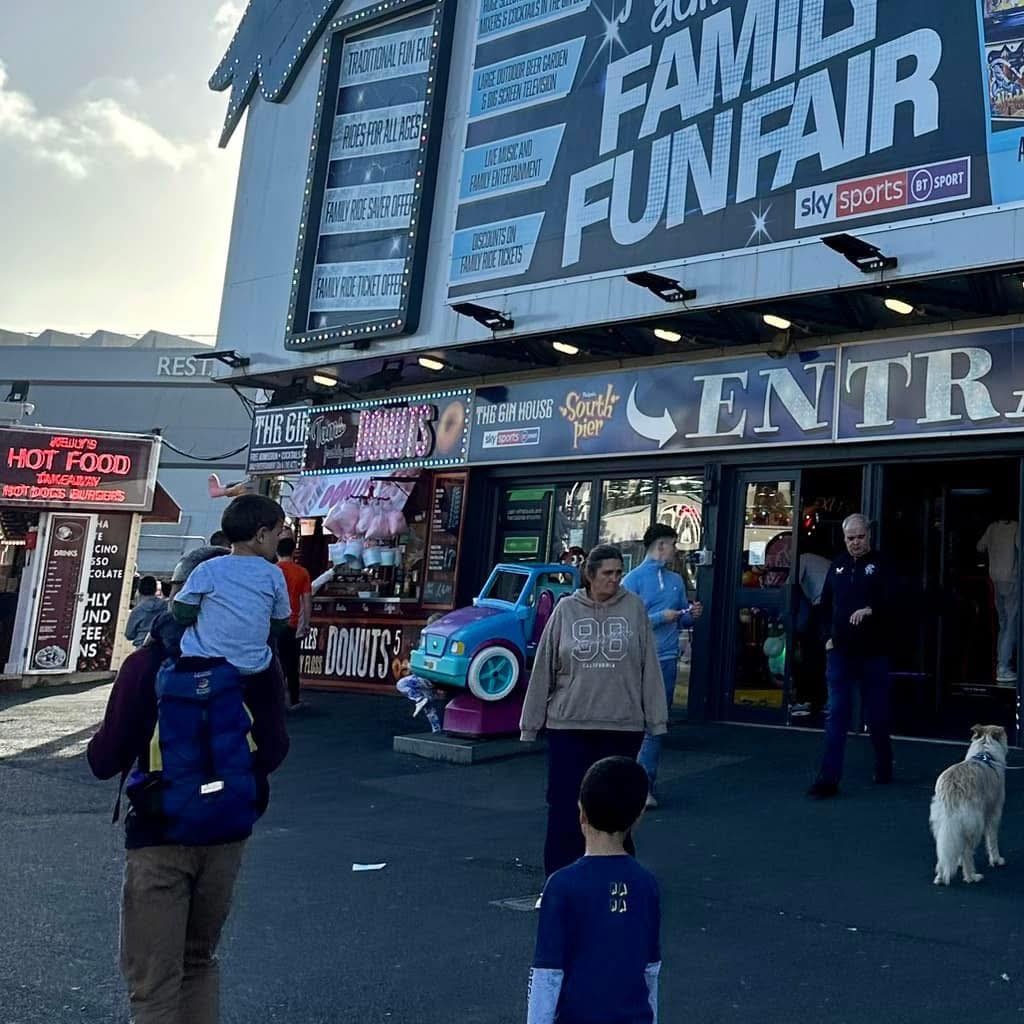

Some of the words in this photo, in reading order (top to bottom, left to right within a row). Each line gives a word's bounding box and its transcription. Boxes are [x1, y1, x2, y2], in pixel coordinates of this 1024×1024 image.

[398, 39, 416, 66] FUN
[477, 71, 496, 92] LARGE
[496, 62, 525, 85] OUTDOOR
[526, 55, 542, 76] BEER
[542, 48, 569, 71] GARDEN
[498, 83, 521, 105] SCREEN
[522, 73, 558, 97] TELEVISION
[342, 122, 365, 150] RIDES
[365, 119, 382, 146] FOR
[384, 116, 399, 143] ALL
[562, 28, 943, 268] FUNFAIR
[484, 150, 497, 168] LIVE
[498, 144, 517, 165] MUSIC
[518, 139, 533, 159] AND
[469, 172, 491, 193] FAMILY
[491, 159, 543, 188] ENTERTAINMENT
[325, 200, 350, 224] FAMILY
[351, 197, 368, 221] RIDE
[368, 193, 390, 219] SAVER
[801, 190, 832, 219] sky
[839, 179, 903, 213] sports
[915, 178, 928, 192] BT
[934, 171, 964, 189] SPORT
[472, 228, 506, 251] DISCOUNTS
[506, 226, 517, 243] ON
[460, 254, 482, 274] FAMILY
[482, 250, 497, 269] RIDE
[497, 245, 523, 265] TICKETS
[315, 277, 340, 300] FAMILY
[341, 275, 357, 298] RIDE
[358, 274, 382, 297] TICKET
[476, 405, 496, 425] THE
[498, 401, 516, 424] GIN
[518, 397, 554, 422] HOUSE
[566, 383, 614, 422] South
[255, 413, 283, 445] THE
[574, 418, 604, 449] pier
[7, 447, 60, 471] HOT
[65, 451, 132, 475] FOOD
[69, 488, 126, 502] BURGERS
[325, 625, 391, 679] DONUTS
[393, 629, 401, 655] 5
[572, 616, 629, 661] 98
